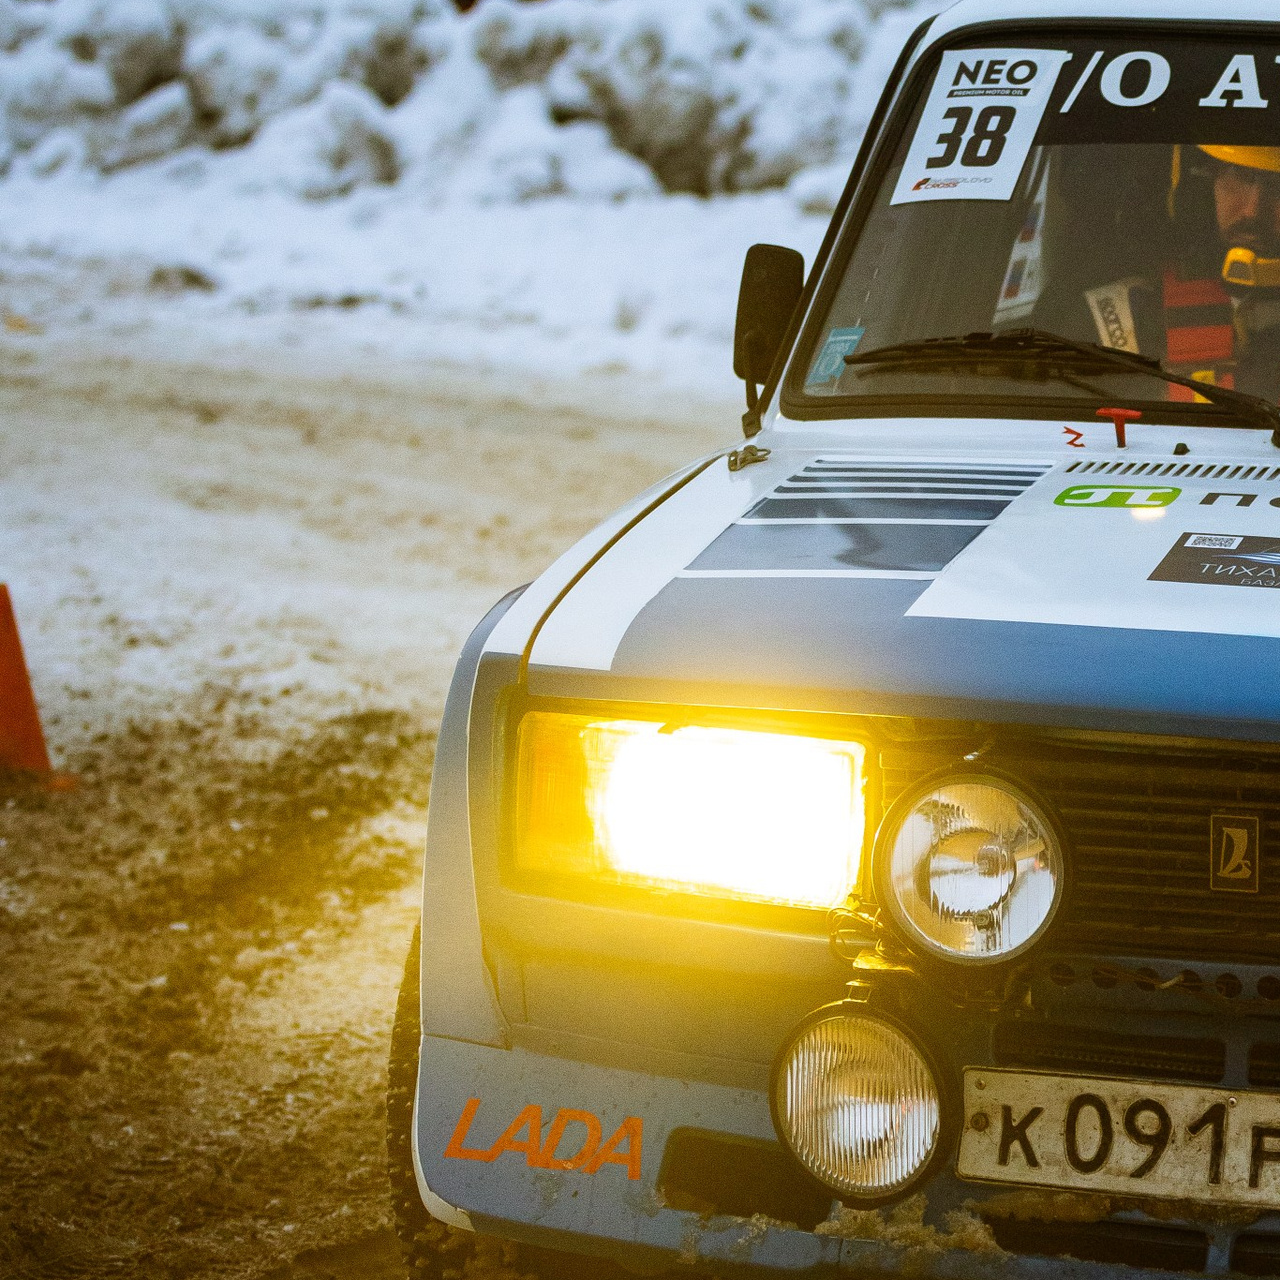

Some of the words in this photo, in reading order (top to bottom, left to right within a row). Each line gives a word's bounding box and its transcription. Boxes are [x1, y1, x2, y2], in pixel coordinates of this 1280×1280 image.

[952, 59, 1038, 87] NEO
[1060, 50, 1171, 113] /O
[925, 105, 1017, 169] 38
[443, 1098, 644, 1180] LADA
